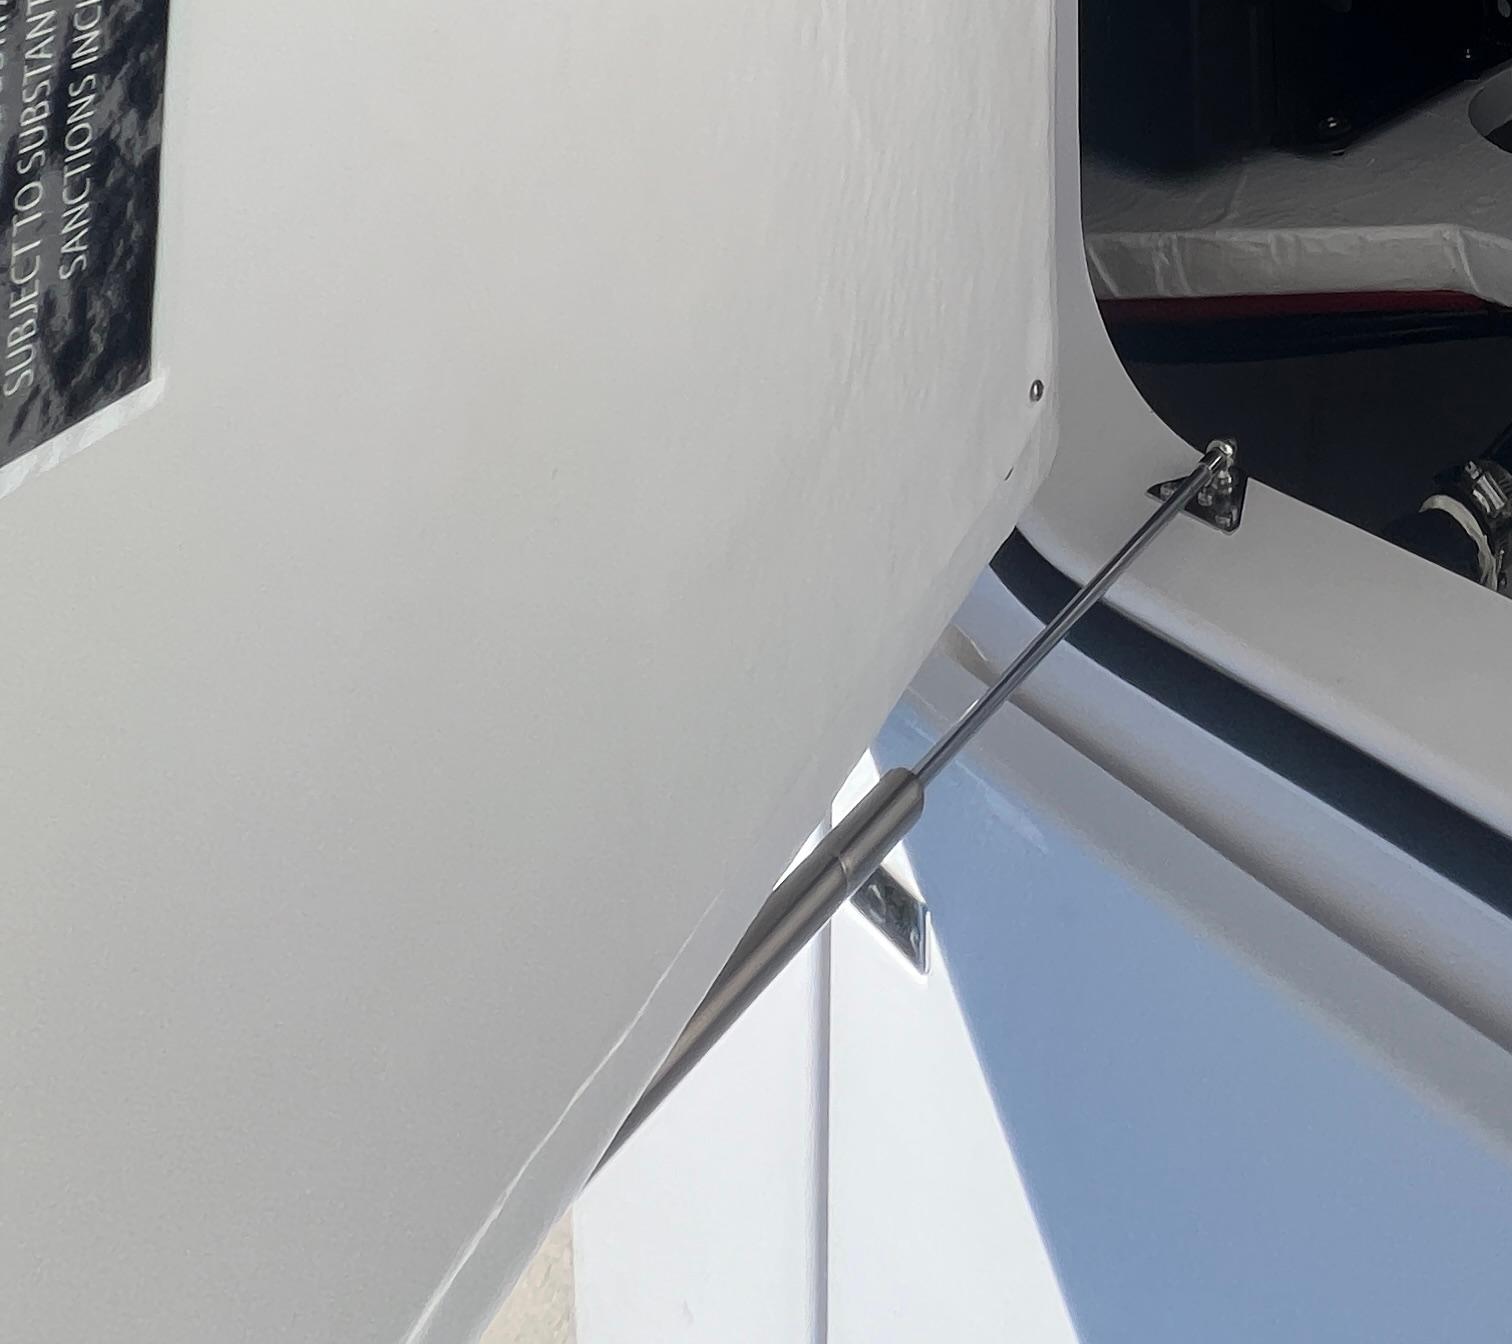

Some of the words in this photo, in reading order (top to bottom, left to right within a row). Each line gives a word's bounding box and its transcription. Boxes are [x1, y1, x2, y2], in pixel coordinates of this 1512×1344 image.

[12, 180, 44, 232] TO
[58, 73, 97, 280] SANCTIONS
[3, 240, 42, 397] SUBJECT
